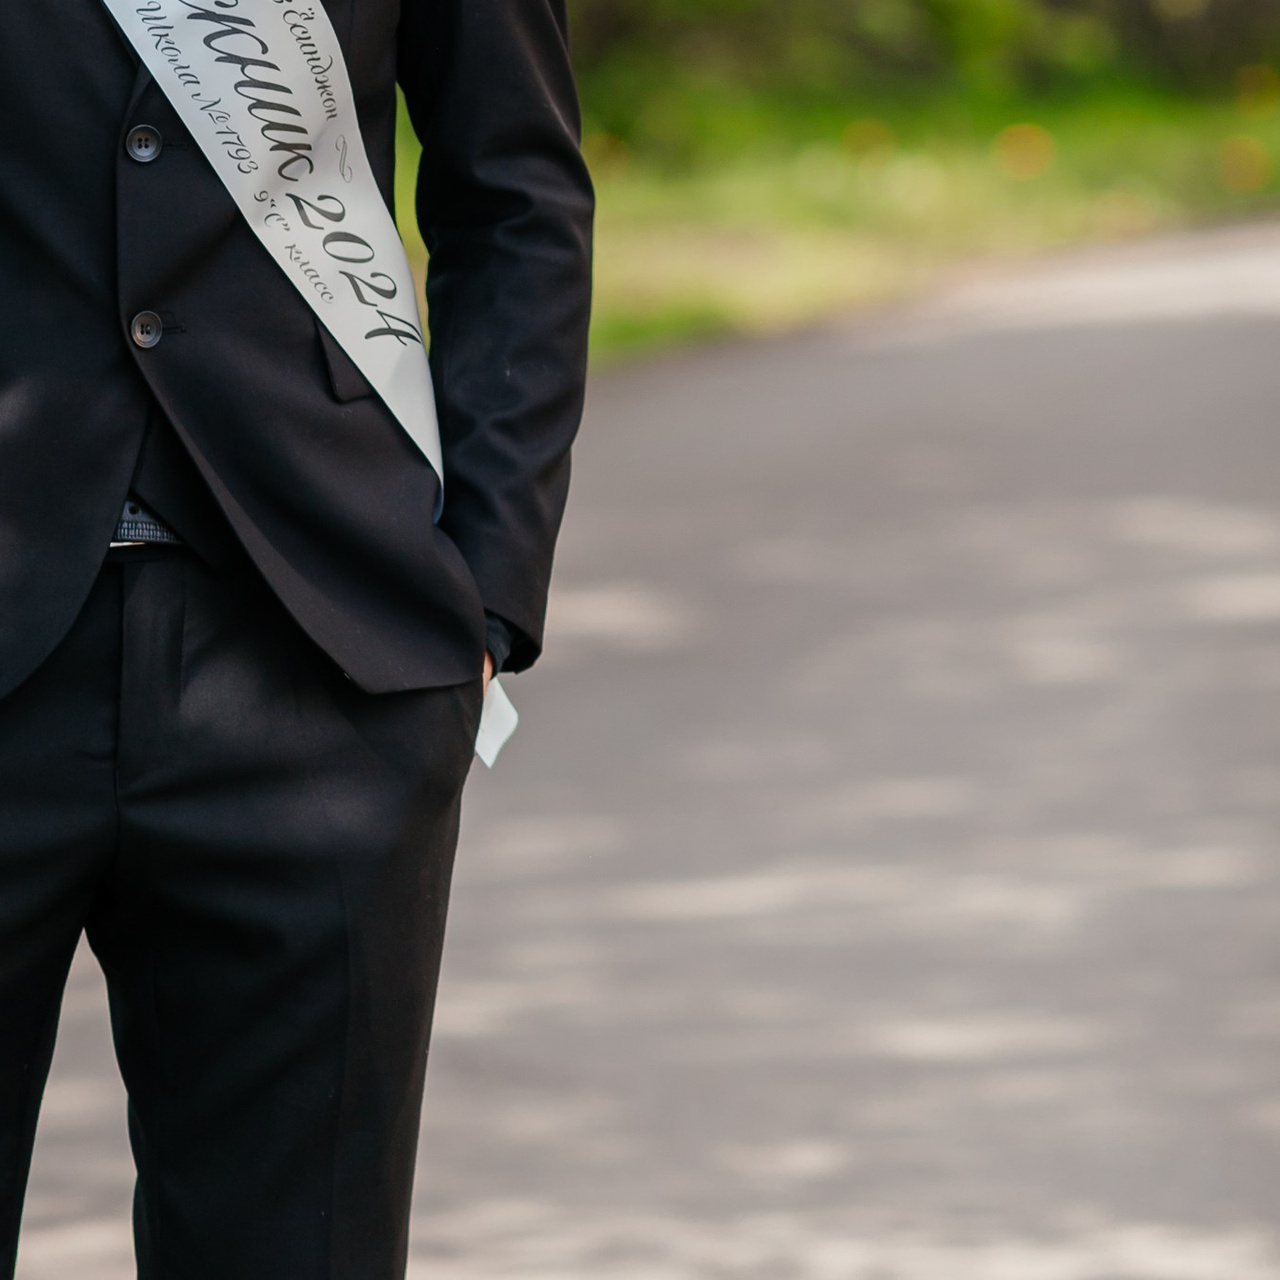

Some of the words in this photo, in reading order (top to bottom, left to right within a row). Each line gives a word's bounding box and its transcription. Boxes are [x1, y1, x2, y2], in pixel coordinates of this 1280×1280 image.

[135, 0, 201, 87] Школа
[285, 242, 334, 305] класс
[284, 191, 422, 347] 2024
